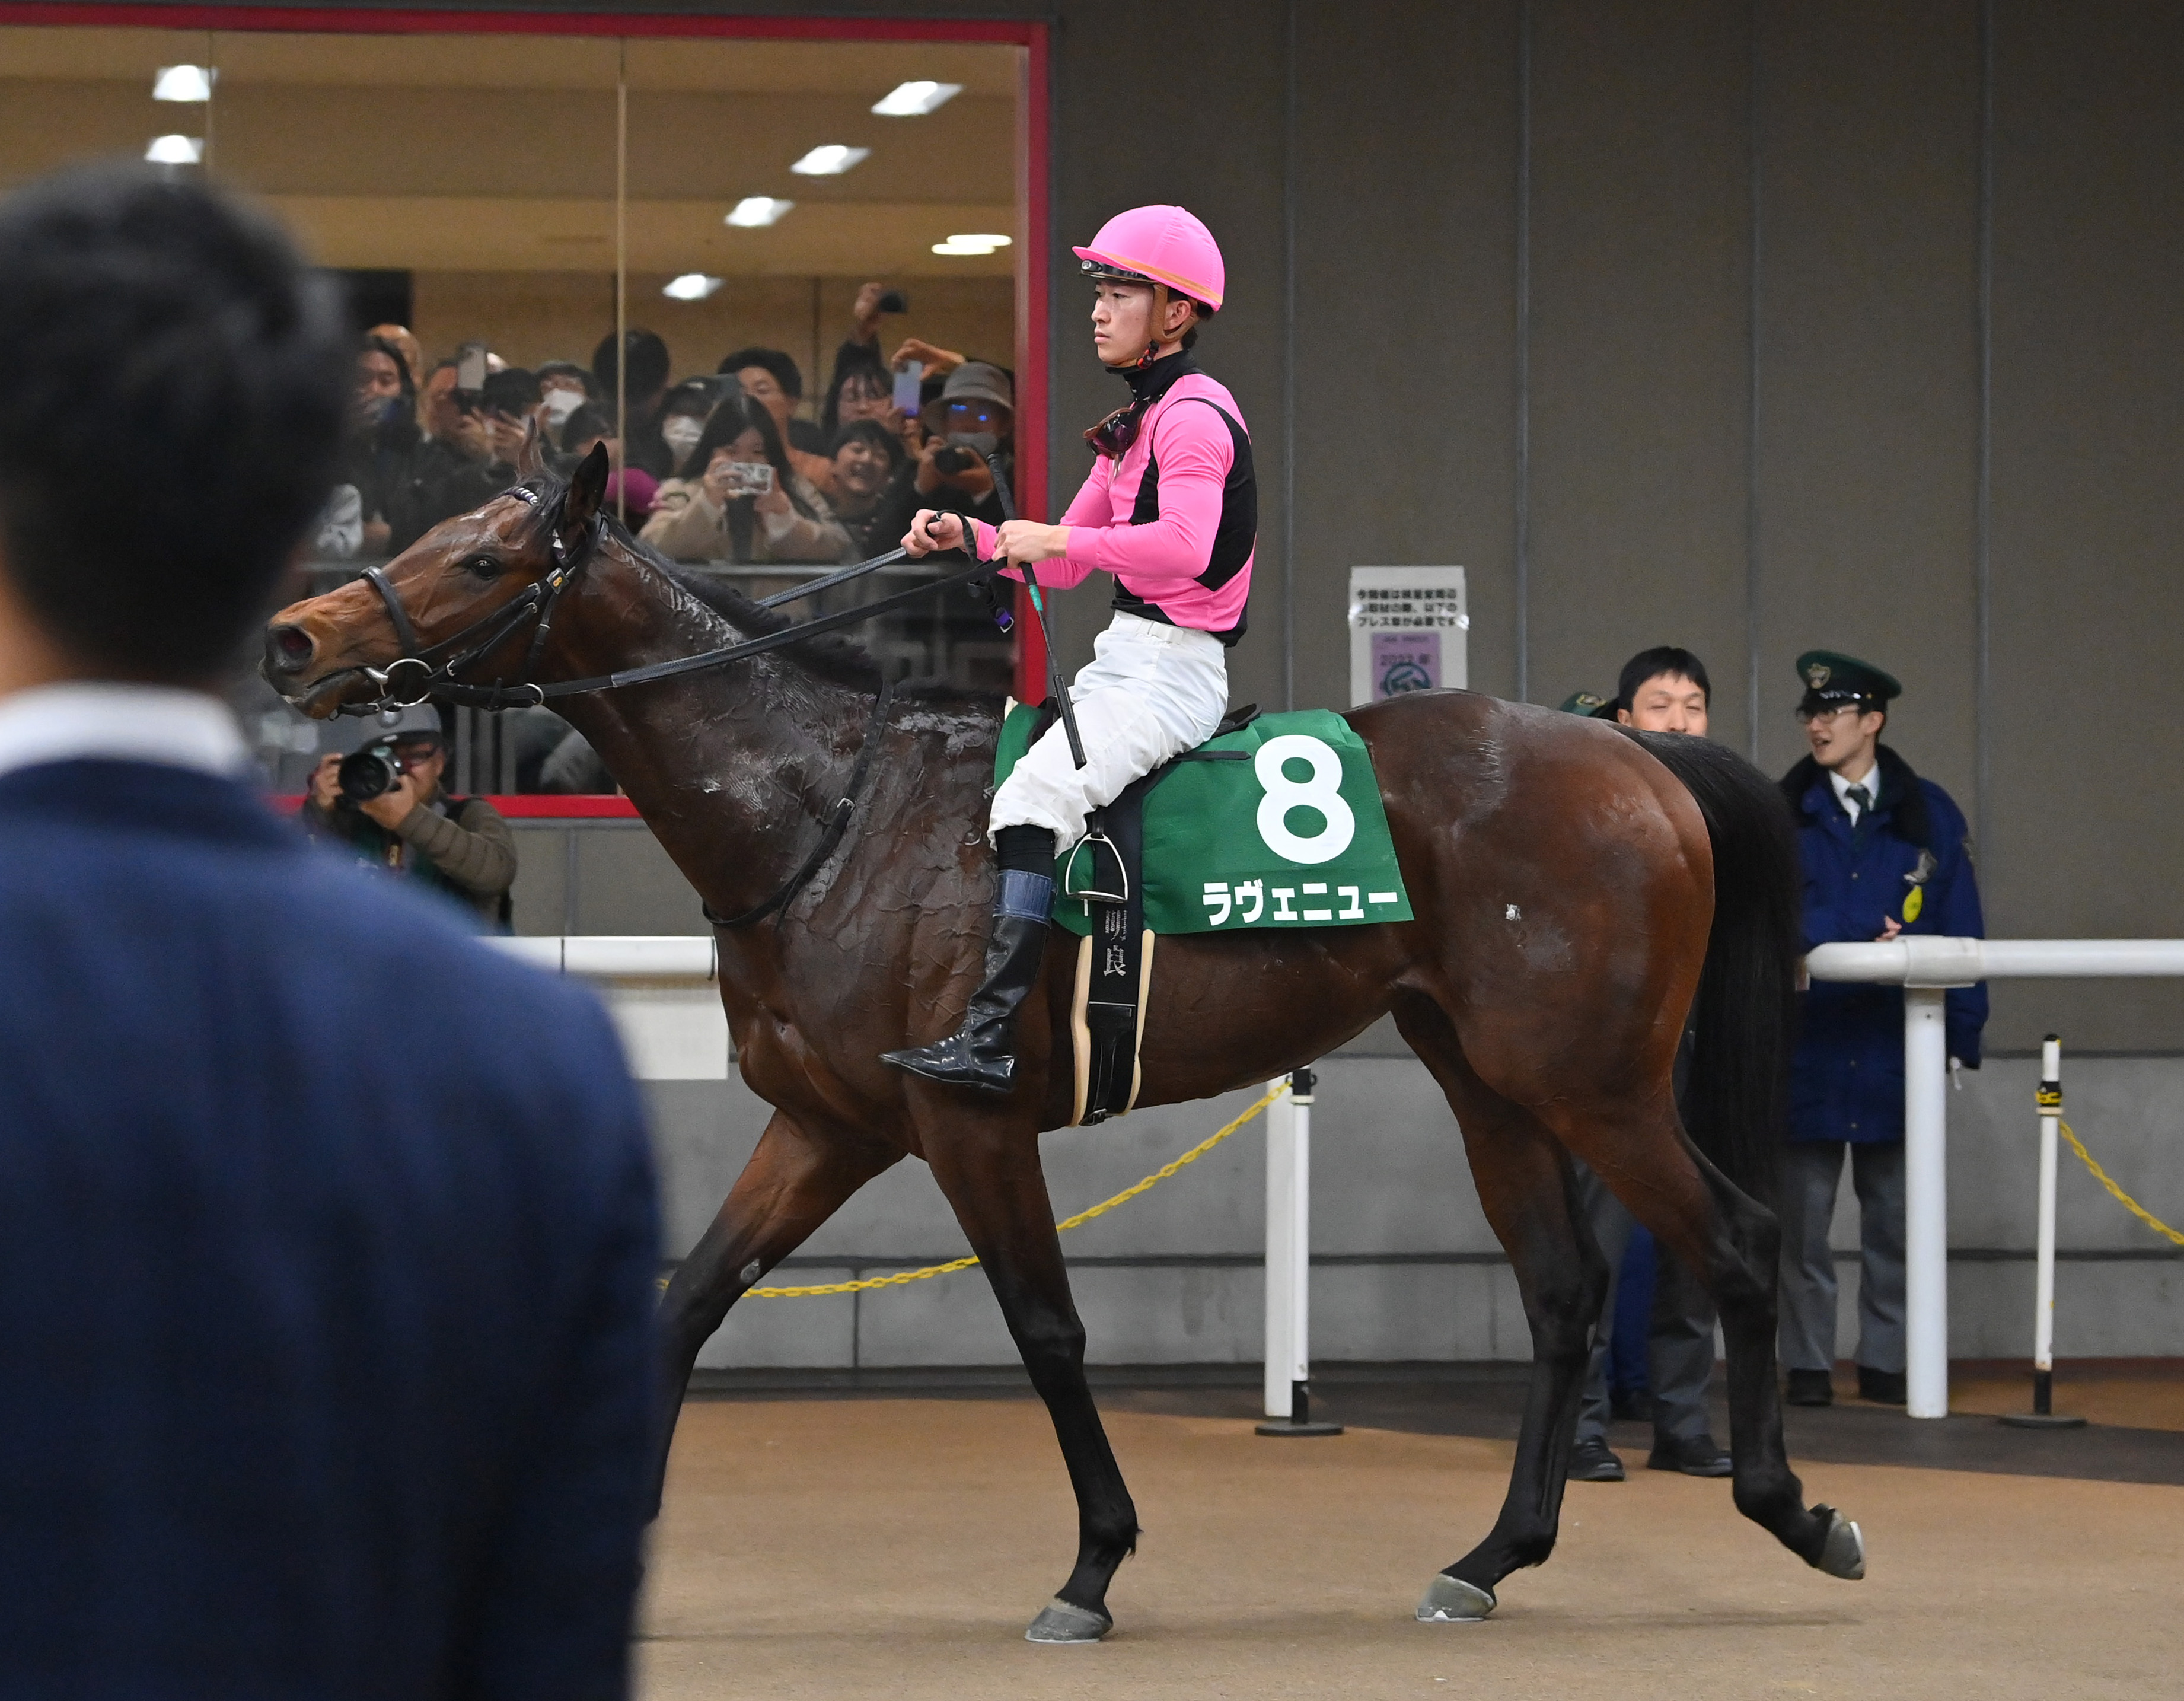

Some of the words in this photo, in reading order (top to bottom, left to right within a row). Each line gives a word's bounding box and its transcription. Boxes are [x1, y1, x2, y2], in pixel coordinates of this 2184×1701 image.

[553, 576, 563, 587] 8
[1254, 734, 1356, 865] 8
[1202, 878, 1398, 926] ラヴェニュー
